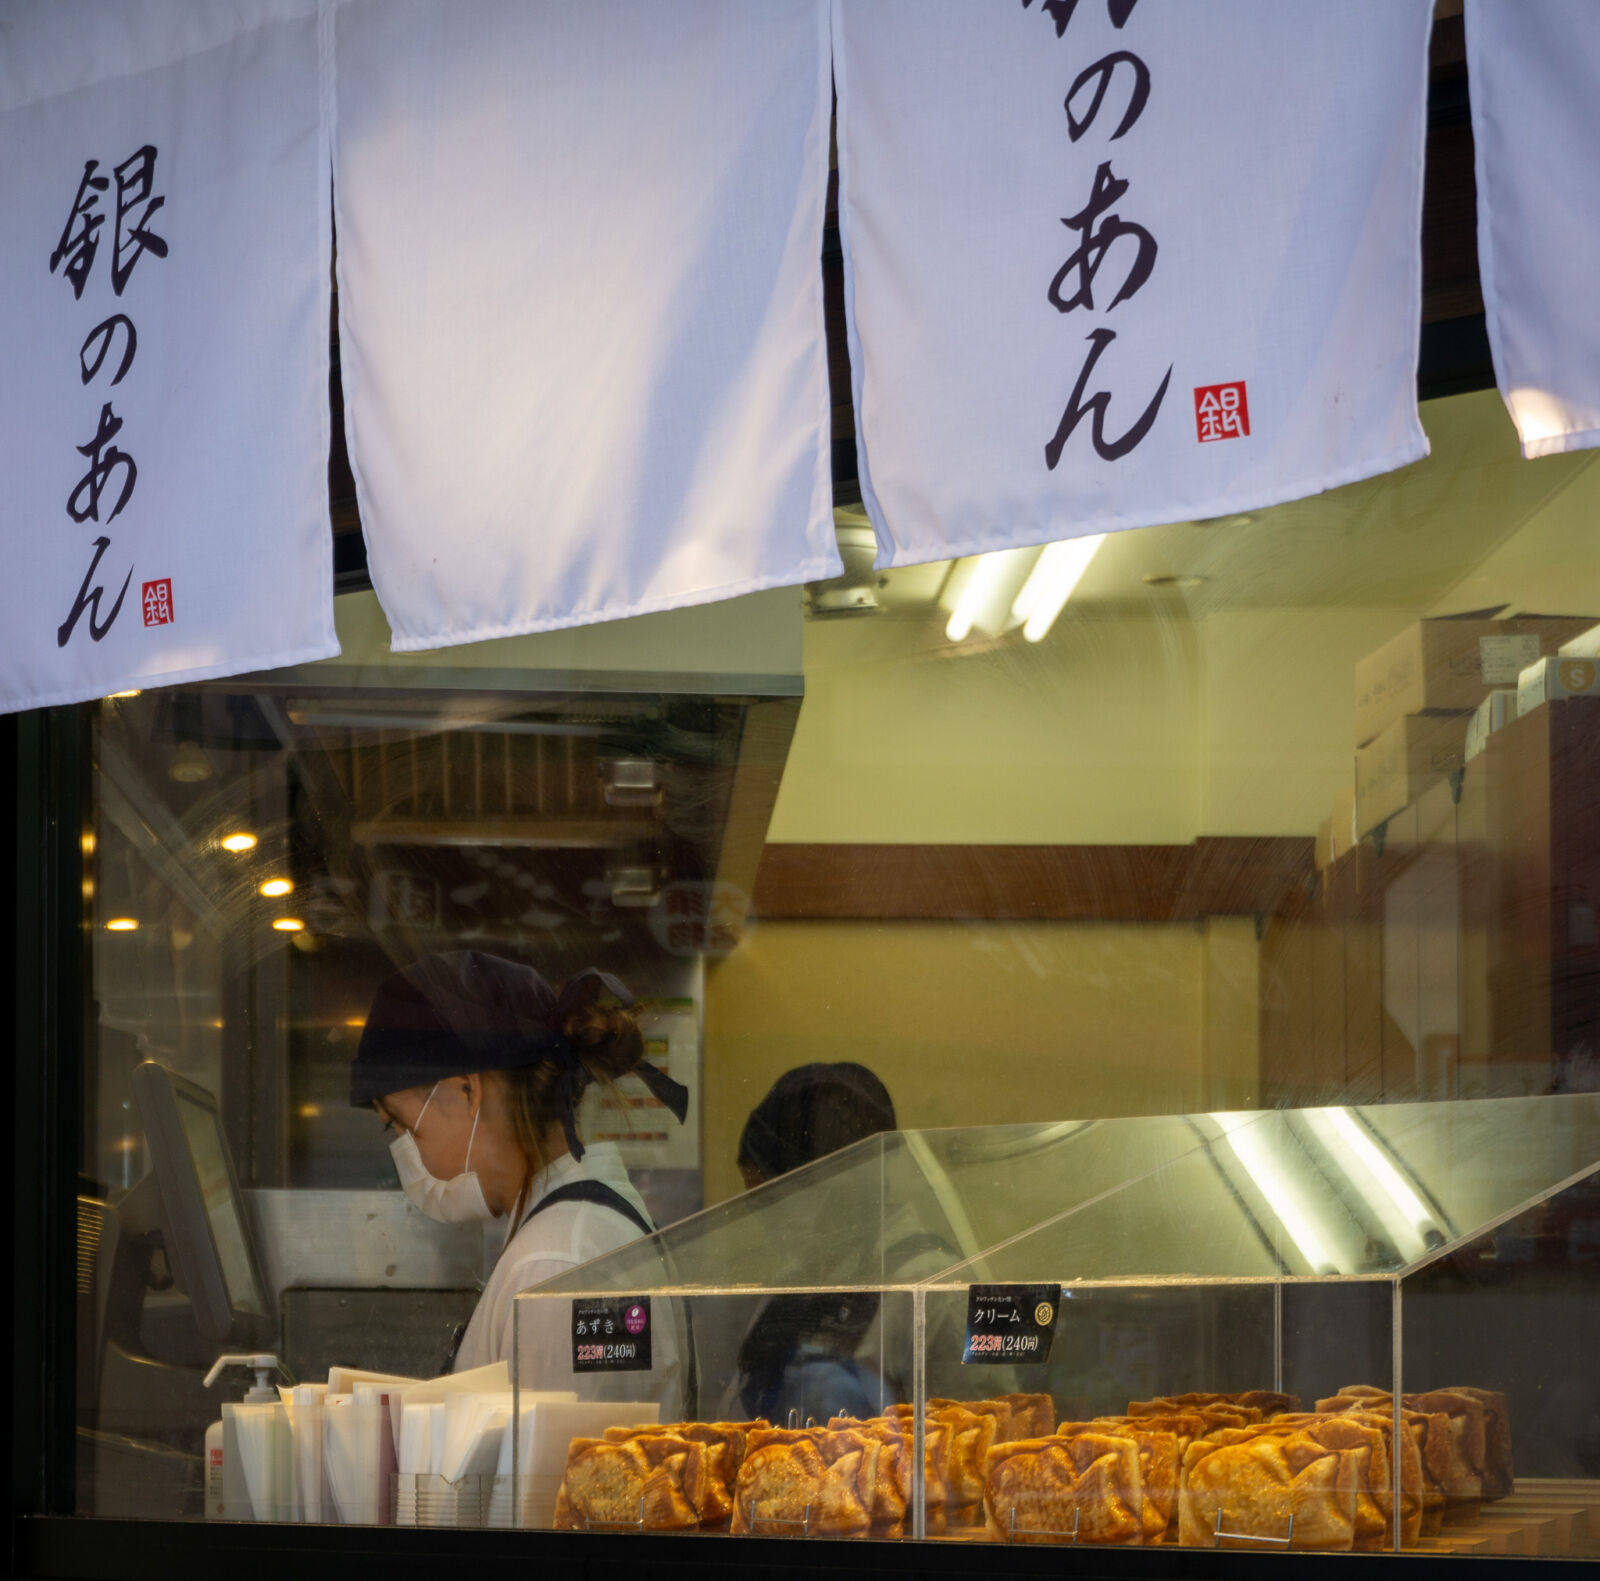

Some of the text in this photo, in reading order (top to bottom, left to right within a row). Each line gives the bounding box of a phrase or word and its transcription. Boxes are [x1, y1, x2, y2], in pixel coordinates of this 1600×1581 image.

[50, 144, 168, 648] 銀のあん
[974, 1308, 1020, 1324] クリーム
[576, 1319, 615, 1335] あずき
